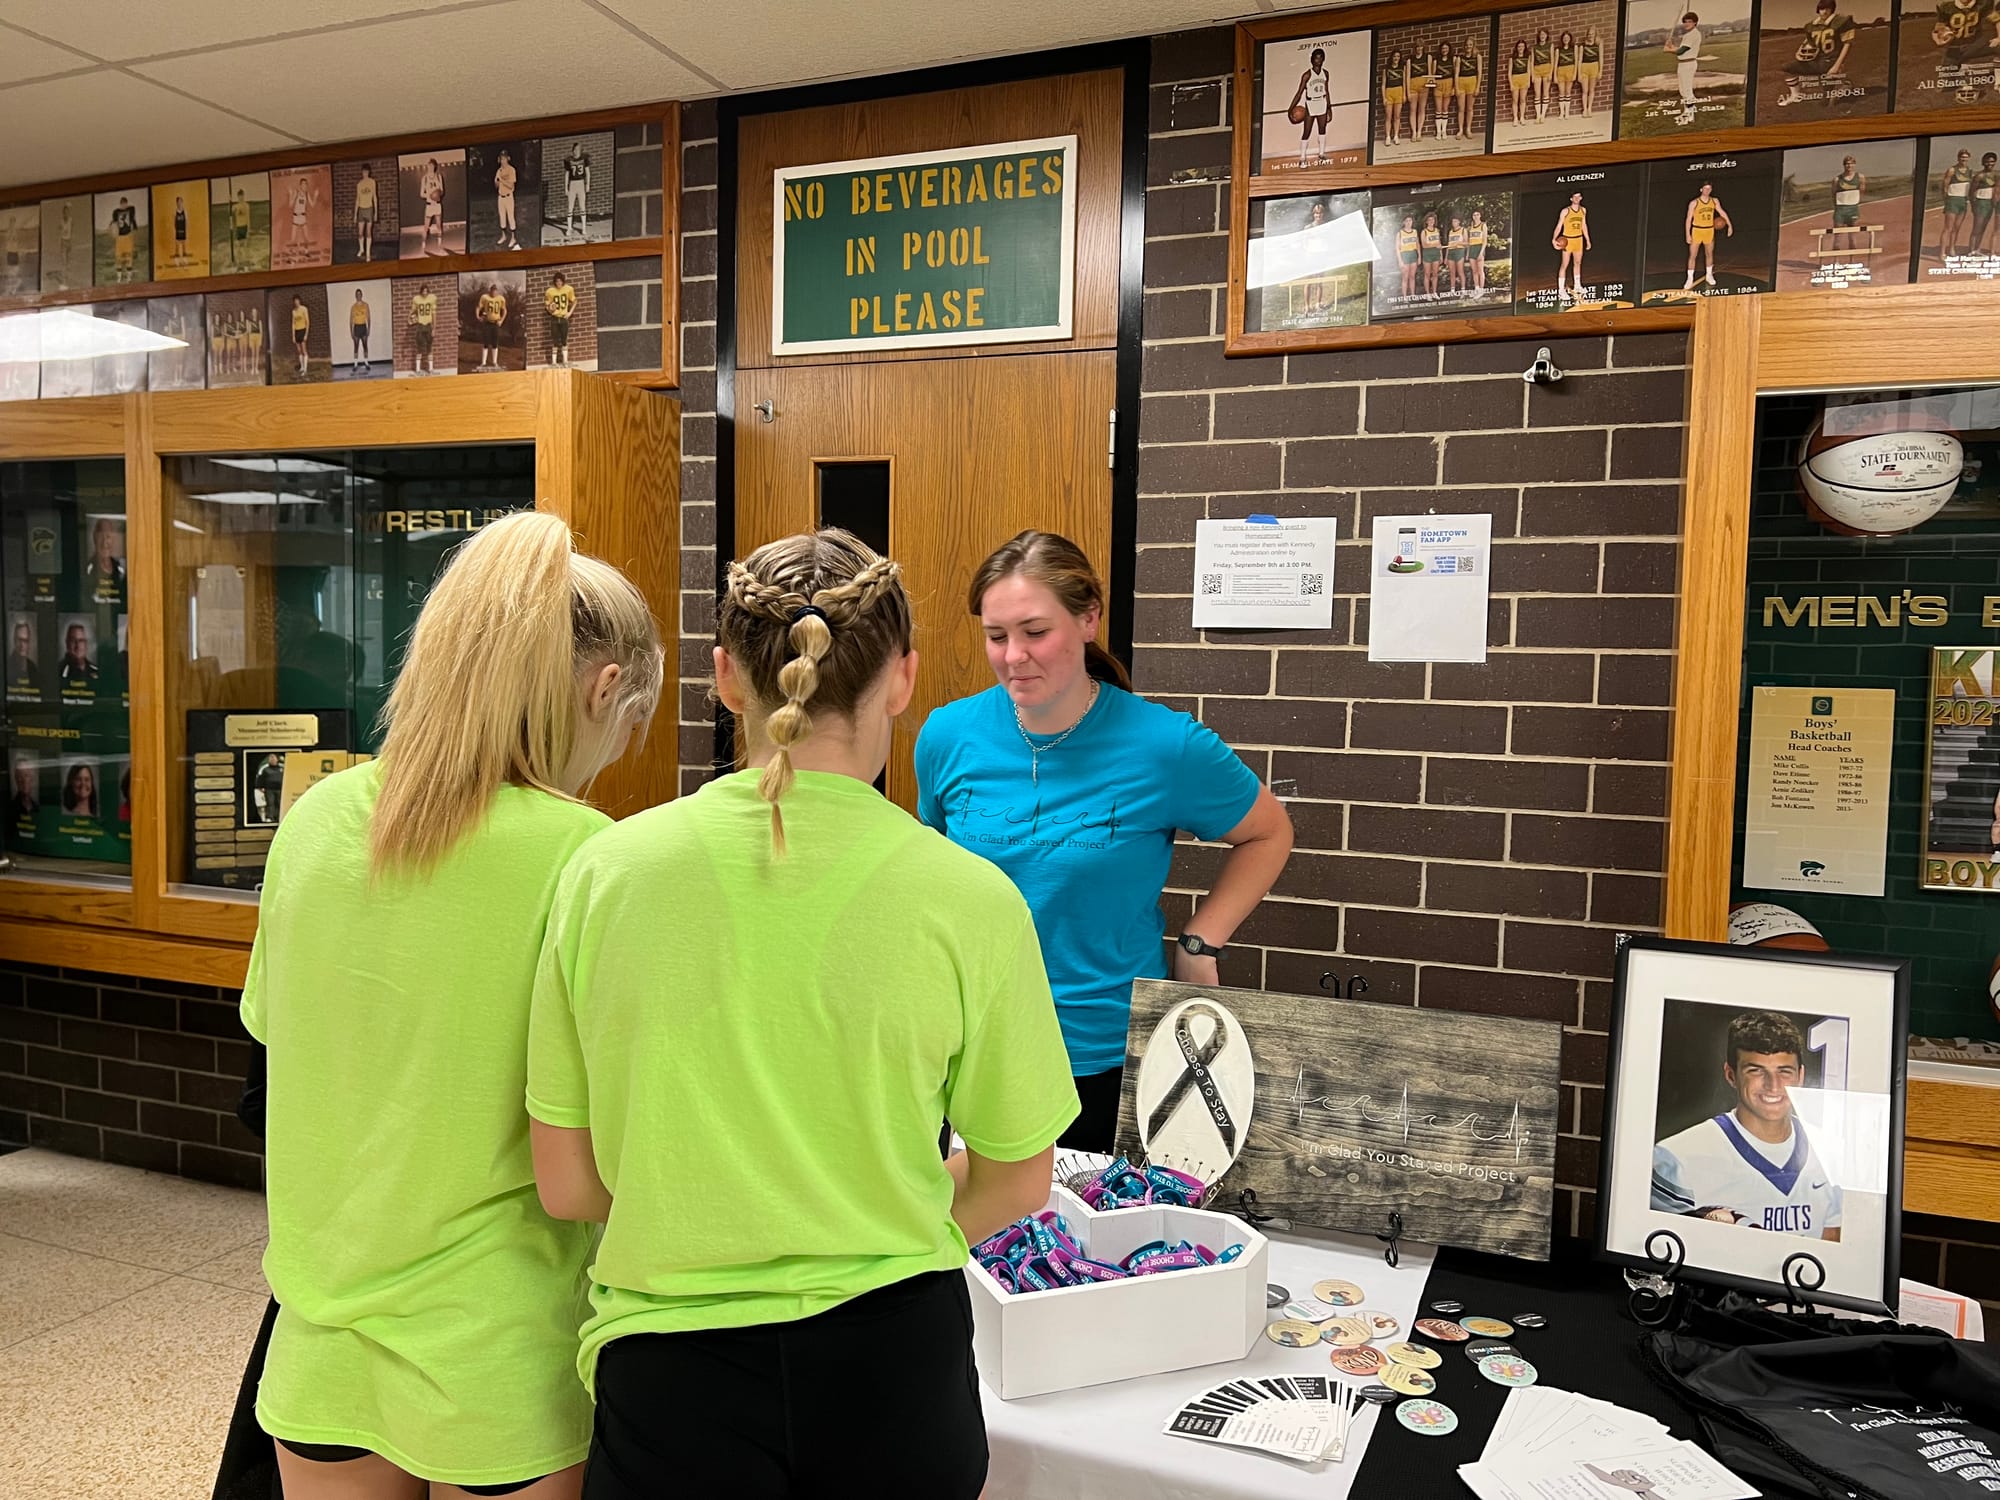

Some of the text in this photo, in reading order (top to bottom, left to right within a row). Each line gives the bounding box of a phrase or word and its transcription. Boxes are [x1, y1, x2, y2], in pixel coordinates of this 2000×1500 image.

[1811, 28, 1836, 54] 76
[1916, 78, 1967, 90] All State
[1794, 87, 1866, 101] State 1980-81
[572, 164, 584, 175] 73
[1556, 172, 1605, 183] AL LORENZEN
[784, 155, 1063, 222] NO BEVERAGES
[846, 225, 990, 276] IN POOL
[1538, 288, 1558, 296] TEAM
[487, 302, 499, 315] 60
[554, 294, 567, 310] 99
[419, 303, 431, 316] 88
[850, 287, 985, 335] PLEASE
[1860, 451, 1952, 469] STATE TOURNAMENT
[1213, 562, 1232, 570] Friday,
[1762, 589, 1948, 628] MEN'S
[1804, 718, 1838, 731] Boys'
[48, 728, 80, 739] SPORTS
[1790, 730, 1852, 742] Basketball
[1788, 743, 1852, 752] Head Coaches
[962, 832, 1106, 850] I'm Glad You Stayed Project
[1927, 859, 2000, 889] BOY
[1177, 1029, 1231, 1128] Choose To Stay
[1328, 1144, 1362, 1160] Glad
[1366, 1148, 1395, 1165] You
[1458, 1162, 1516, 1182] Project
[1104, 1166, 1120, 1182] STAY
[1175, 1184, 1201, 1196] CHOOSE
[1762, 1205, 1812, 1232] BOLTS
[1149, 1256, 1175, 1267] CHOOSE
[1342, 1350, 1379, 1370] KIND
[1868, 1416, 1897, 1429] Glad
